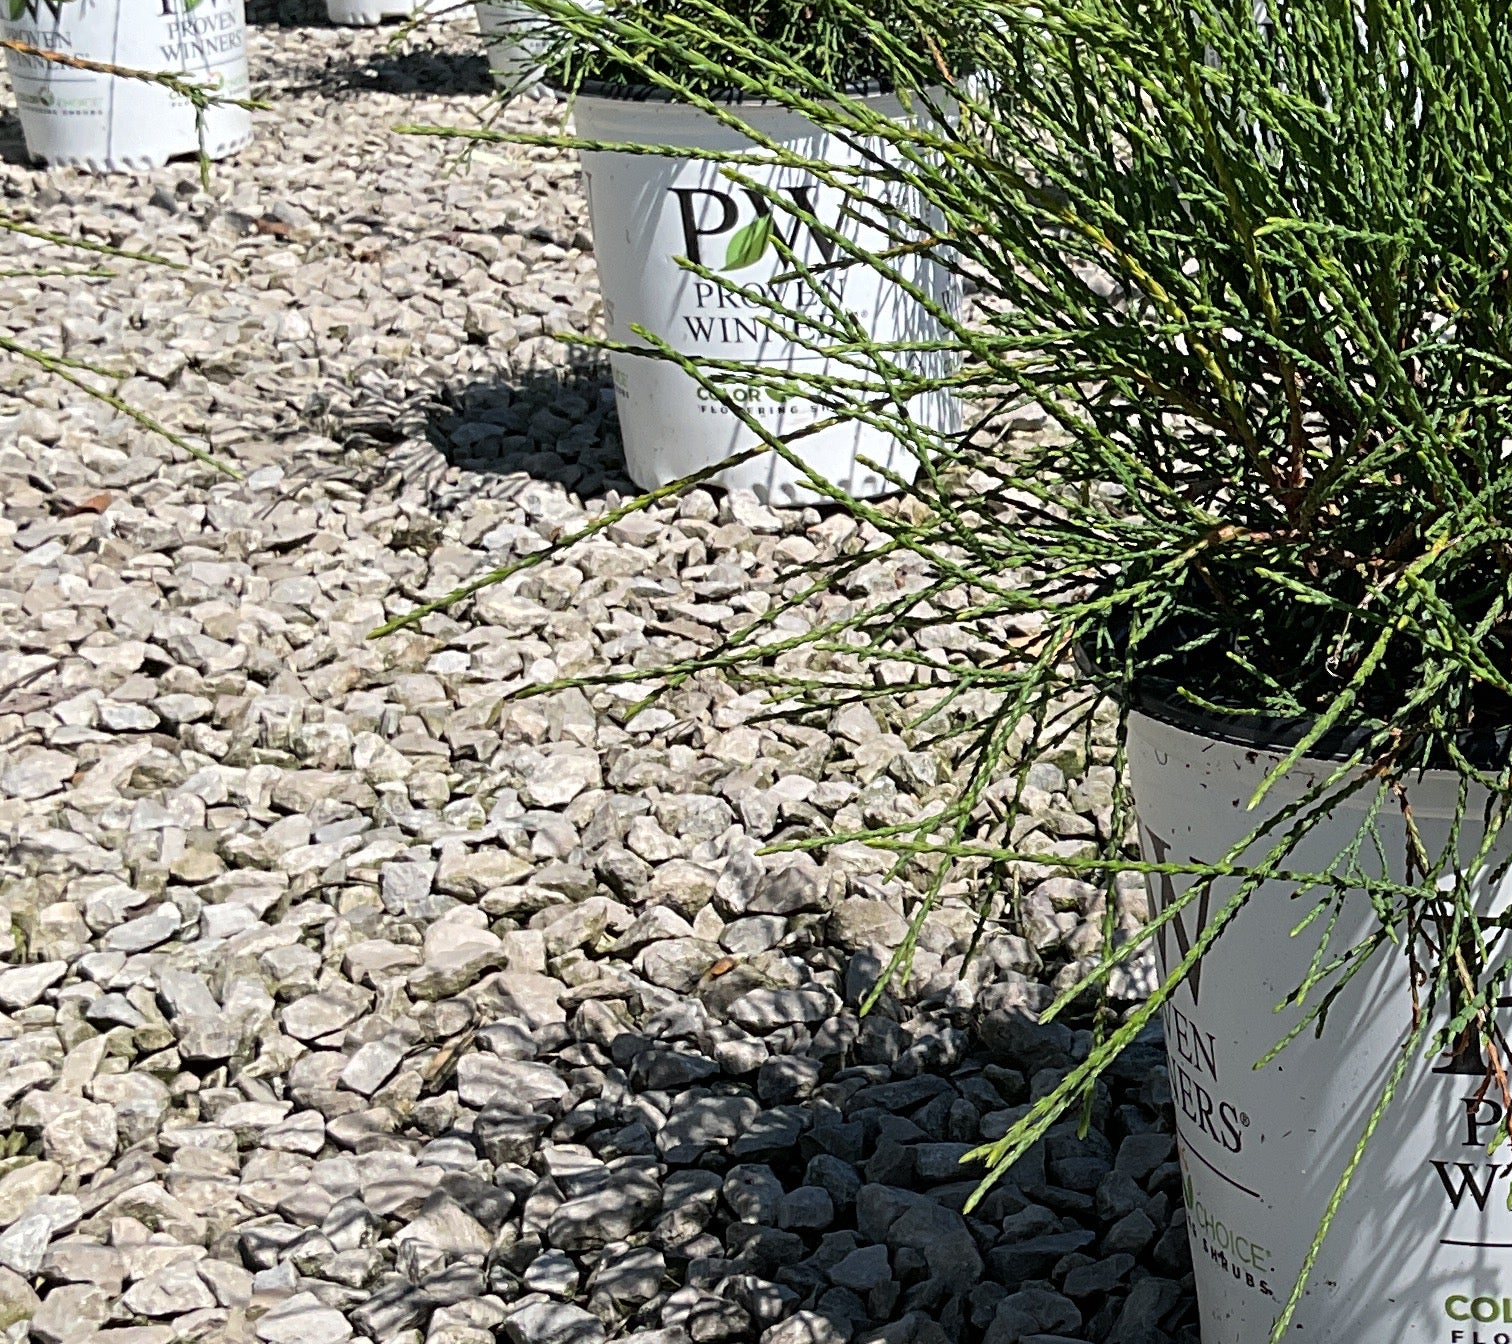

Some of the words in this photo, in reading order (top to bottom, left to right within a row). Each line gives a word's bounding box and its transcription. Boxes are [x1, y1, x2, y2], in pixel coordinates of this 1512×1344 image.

[167, 9, 237, 40] PROVEN
[159, 29, 242, 62] WINNERS
[667, 182, 861, 271] PW
